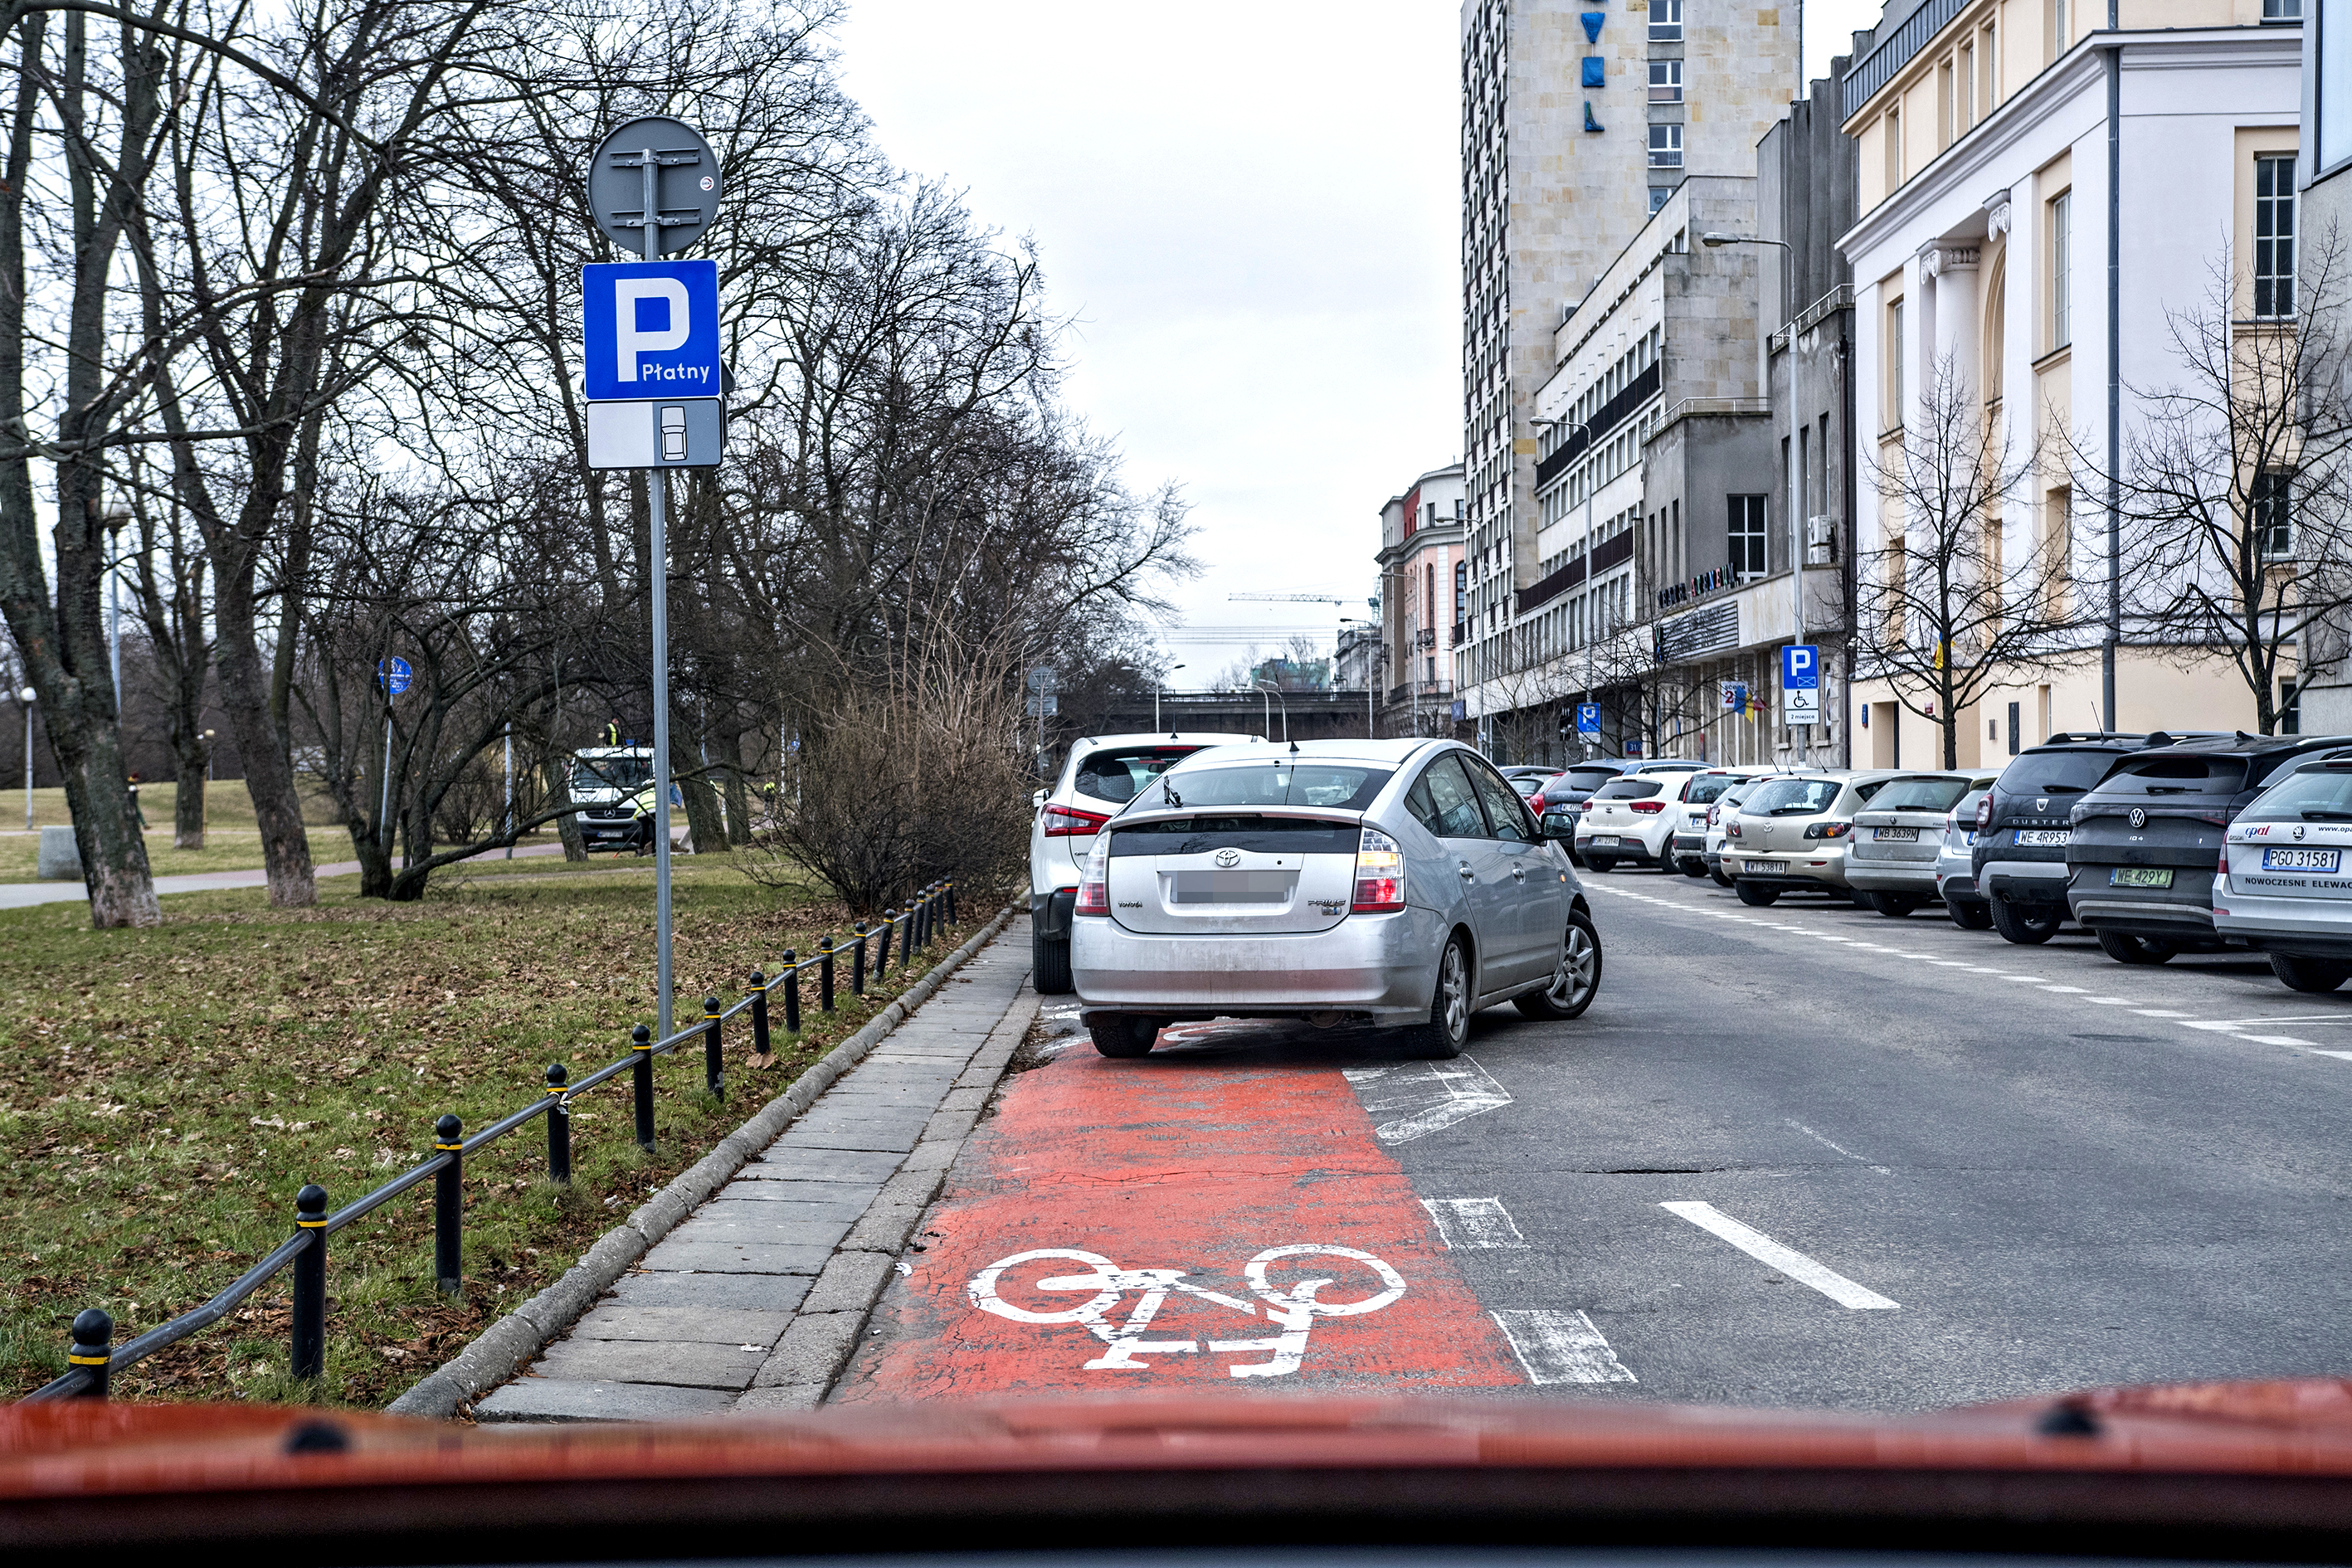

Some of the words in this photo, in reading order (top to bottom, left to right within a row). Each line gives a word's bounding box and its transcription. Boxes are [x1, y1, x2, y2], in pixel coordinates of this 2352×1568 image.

[616, 277, 689, 382] P
[642, 363, 709, 383] Płatny
[1691, 562, 1736, 597] ATENEUM
[1791, 650, 1810, 676] P
[1583, 705, 1595, 723] P
[1878, 828, 1890, 838] WB
[1892, 829, 1917, 839] 3639M
[2021, 831, 2034, 843] WE
[2037, 831, 2067, 844] 4R953
[2245, 825, 2271, 838] opal
[1750, 861, 1759, 871] WT
[1761, 861, 1784, 872] 5381A
[2270, 851, 2294, 865] PGO
[2296, 851, 2335, 868] 31581
[2117, 869, 2132, 883] WE
[2135, 869, 2169, 884] 429YJ
[2245, 877, 2306, 887] NOWOCZESNE
[2312, 880, 2352, 889] ELEWAC
